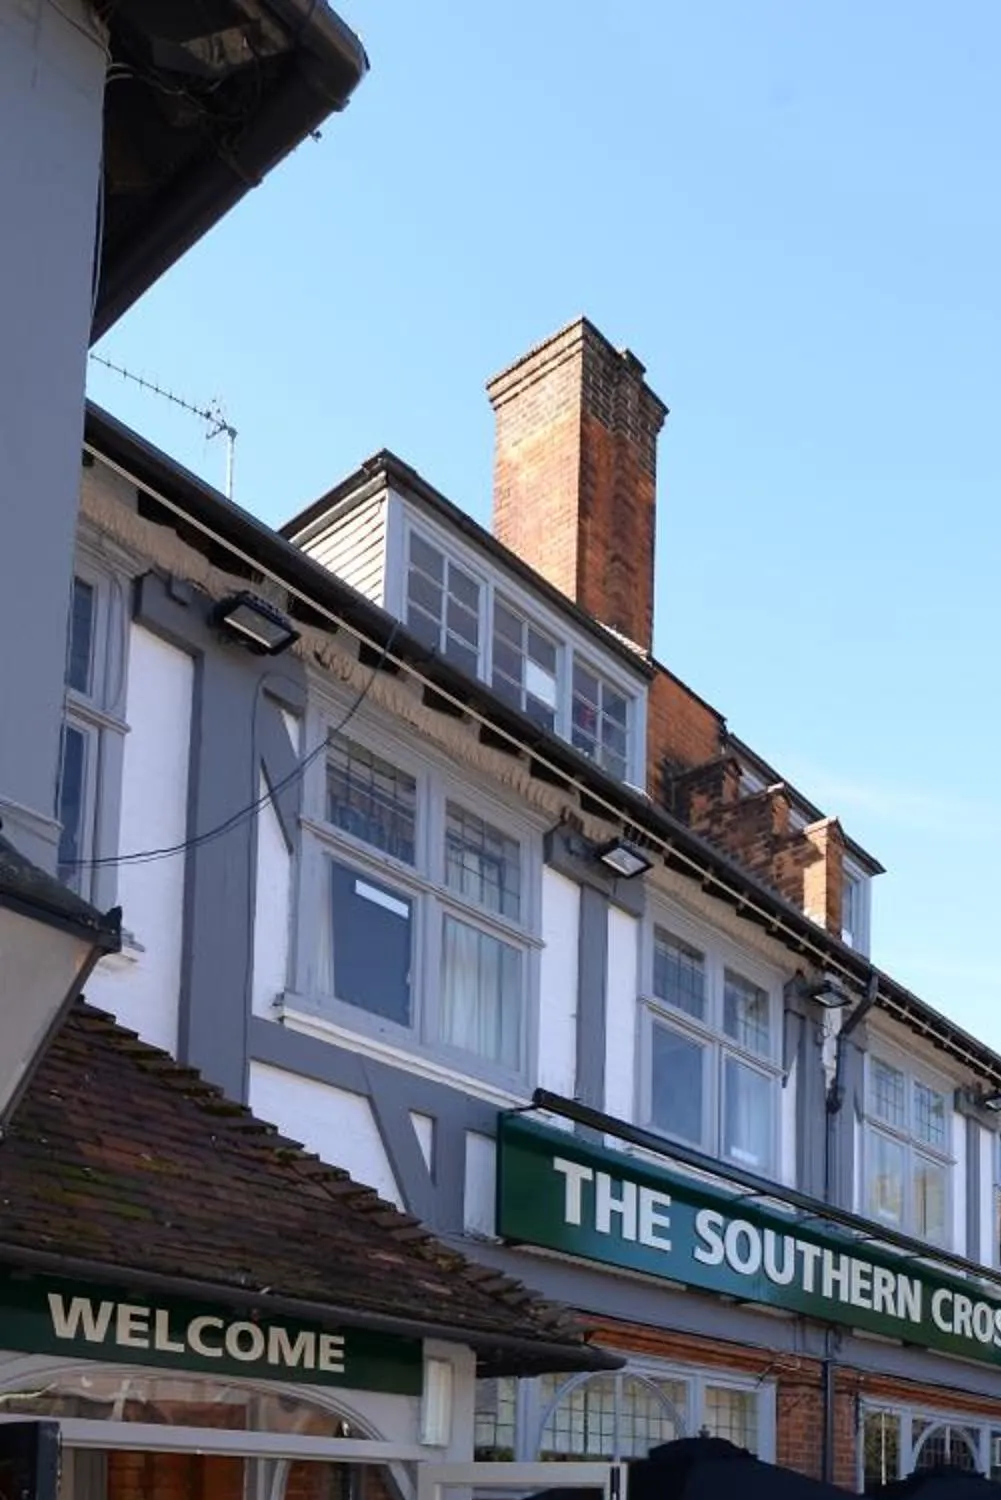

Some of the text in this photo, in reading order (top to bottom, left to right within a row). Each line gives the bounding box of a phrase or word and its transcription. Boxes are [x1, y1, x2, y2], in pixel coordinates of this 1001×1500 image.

[553, 1156, 672, 1252] THE
[694, 1209, 922, 1324] SOUTHERN
[46, 1293, 346, 1373] WELCOME
